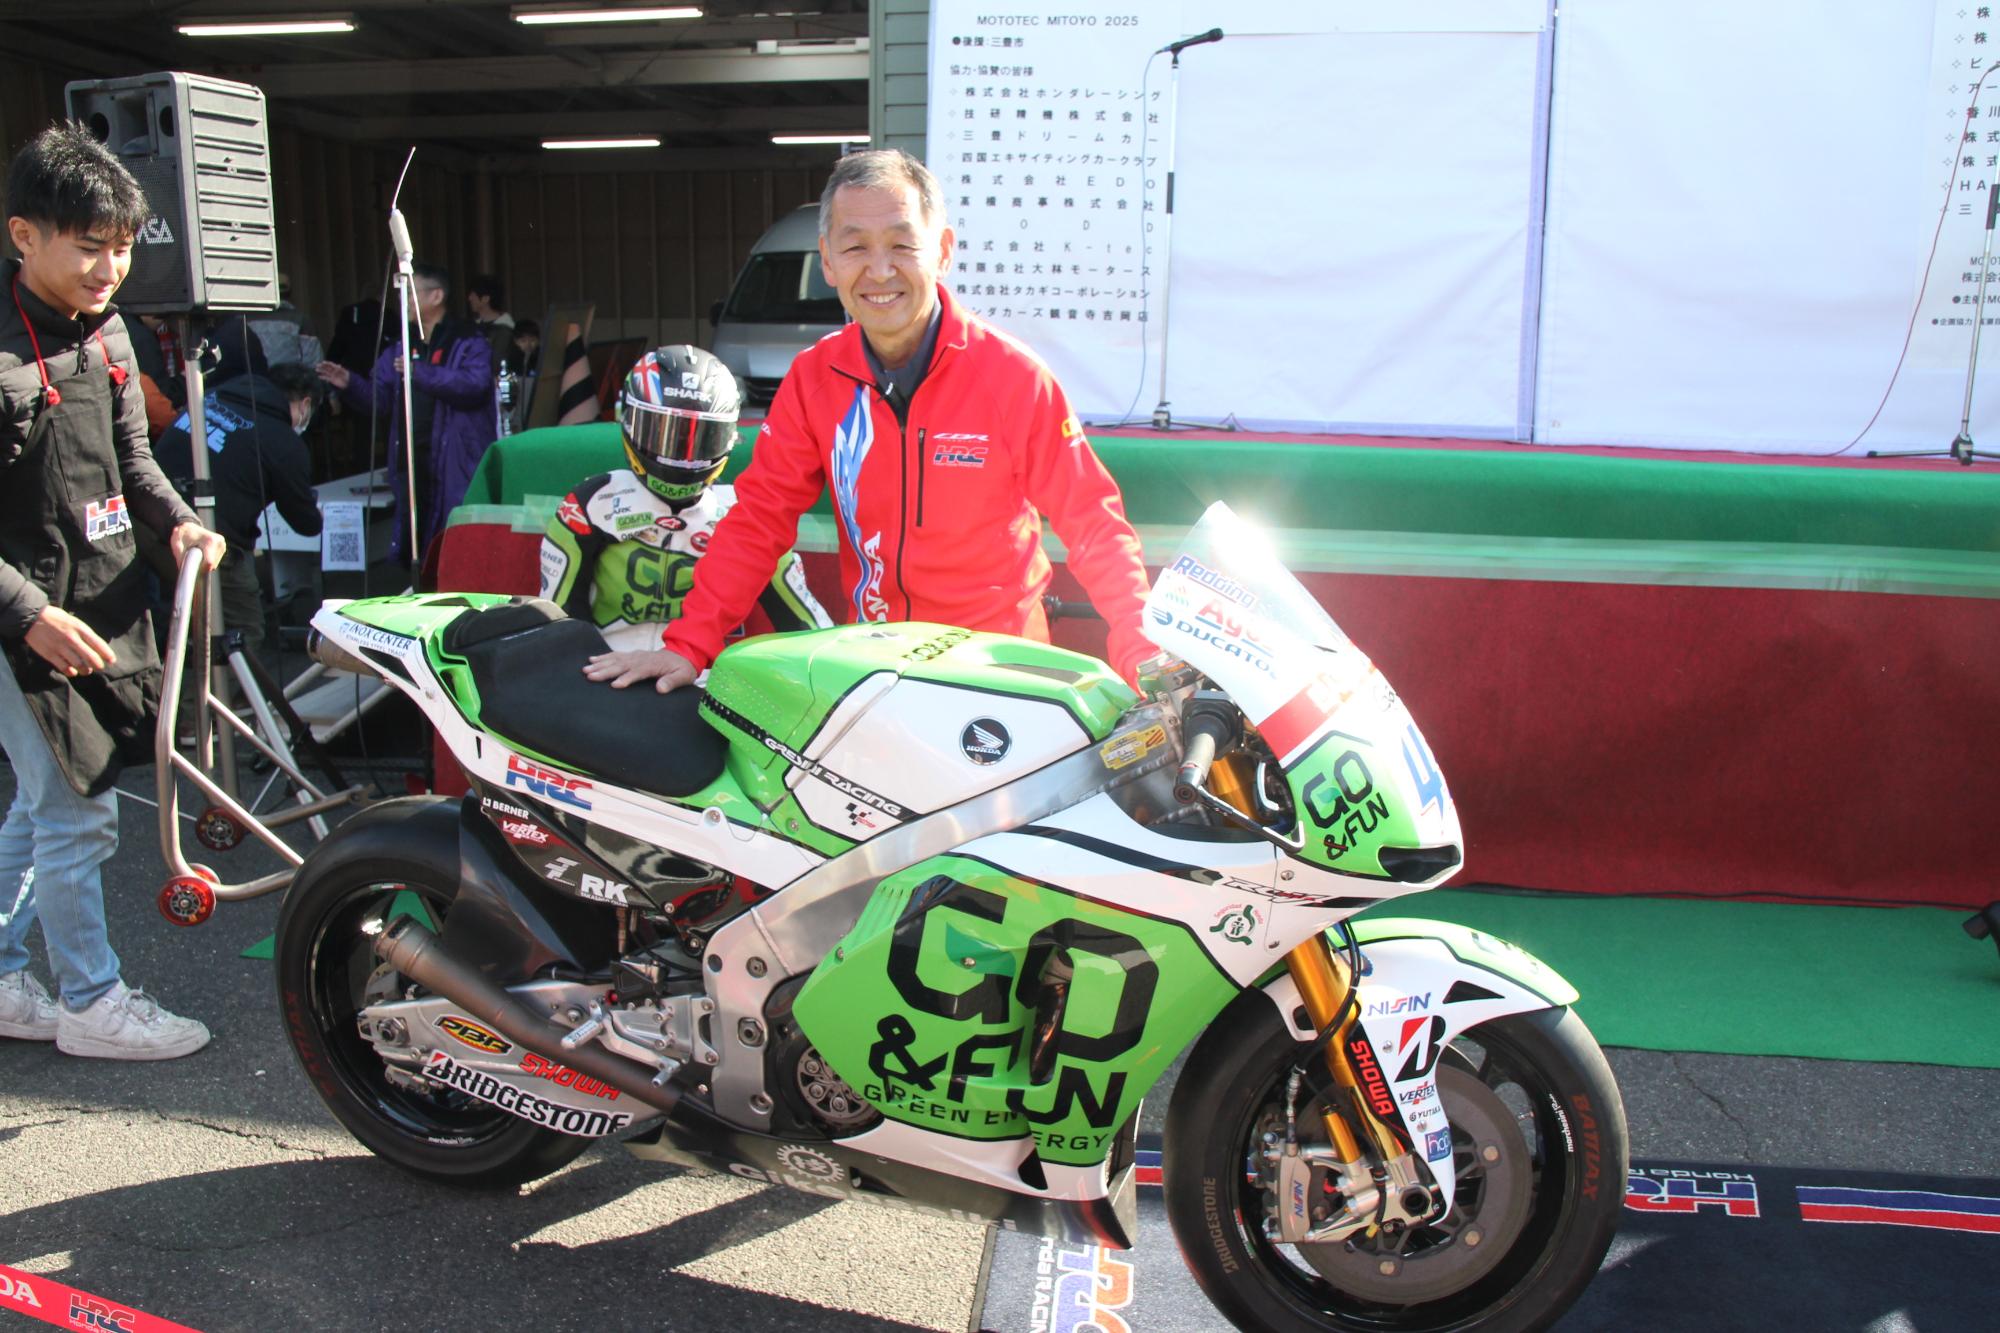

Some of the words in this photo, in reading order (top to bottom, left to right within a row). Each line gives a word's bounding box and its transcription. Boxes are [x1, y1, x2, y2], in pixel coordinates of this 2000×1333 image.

[977, 15, 1039, 26] MOTOTEC
[1047, 15, 1097, 26] MITOYO
[1105, 15, 1139, 26] 2025
[664, 386, 712, 403] SHARK
[966, 745, 1002, 756] HONDA
[506, 754, 593, 811] HRC
[824, 771, 902, 816] RACING
[1302, 750, 1374, 829] GO
[492, 800, 529, 820] BERNER
[502, 819, 550, 843] VERTEX
[581, 873, 630, 904] RK
[887, 873, 1160, 1063] GO
[1368, 992, 1432, 1017] NISSIN
[427, 1052, 630, 1135] BRIDGESTONE
[519, 1053, 621, 1101] SHOWA
[1350, 1040, 1395, 1116] SHOWA
[1399, 1083, 1436, 1102] VERTEX
[863, 1083, 971, 1124] GREEN
[1202, 1176, 1240, 1274] BRIDGESTONE
